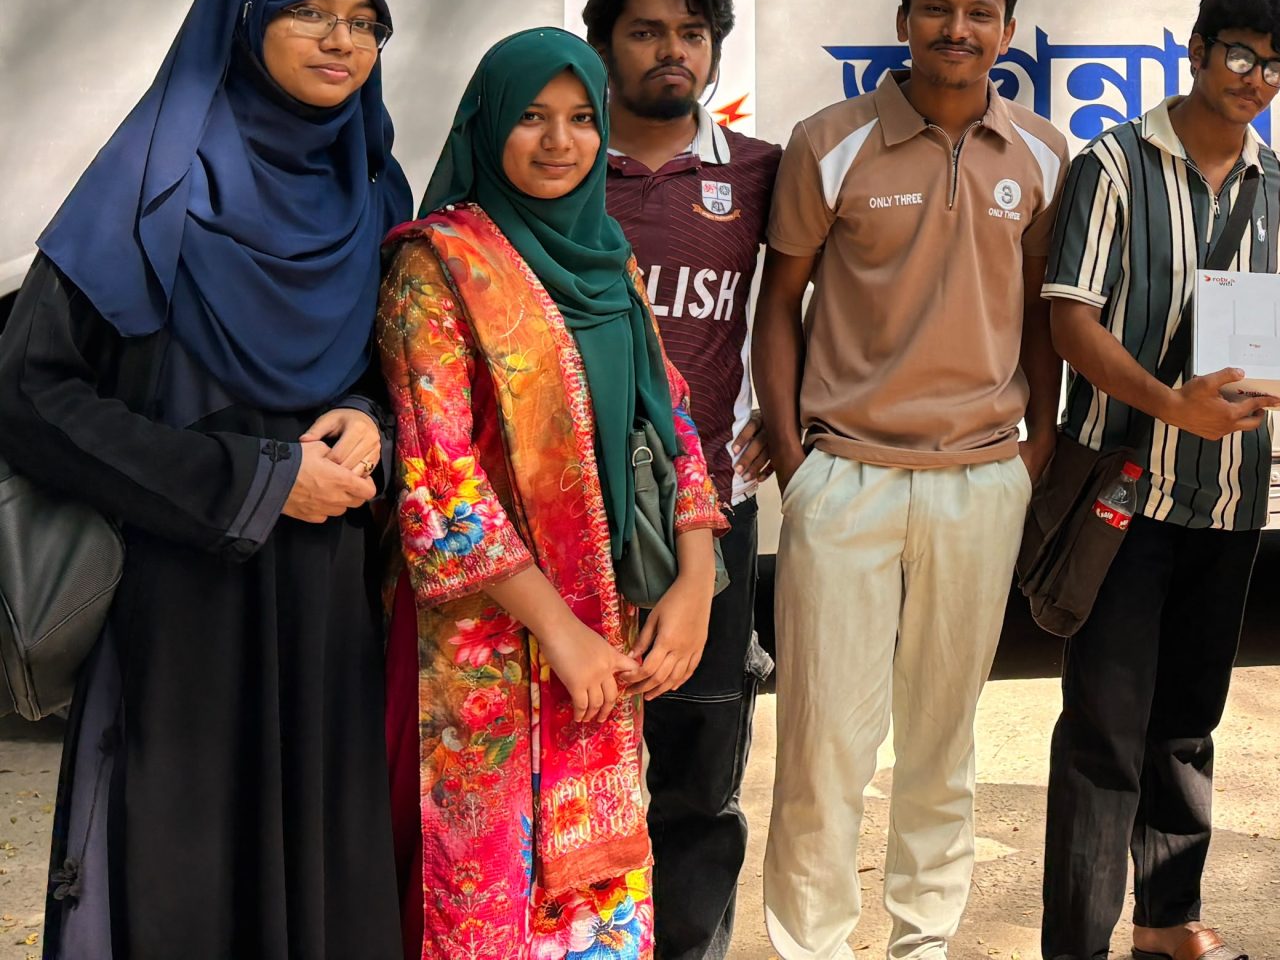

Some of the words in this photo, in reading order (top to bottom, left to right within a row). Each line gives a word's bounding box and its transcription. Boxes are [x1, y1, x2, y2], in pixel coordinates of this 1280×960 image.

[869, 195, 893, 209] ONLY
[893, 192, 923, 206] THREE
[636, 264, 742, 321] LISH
